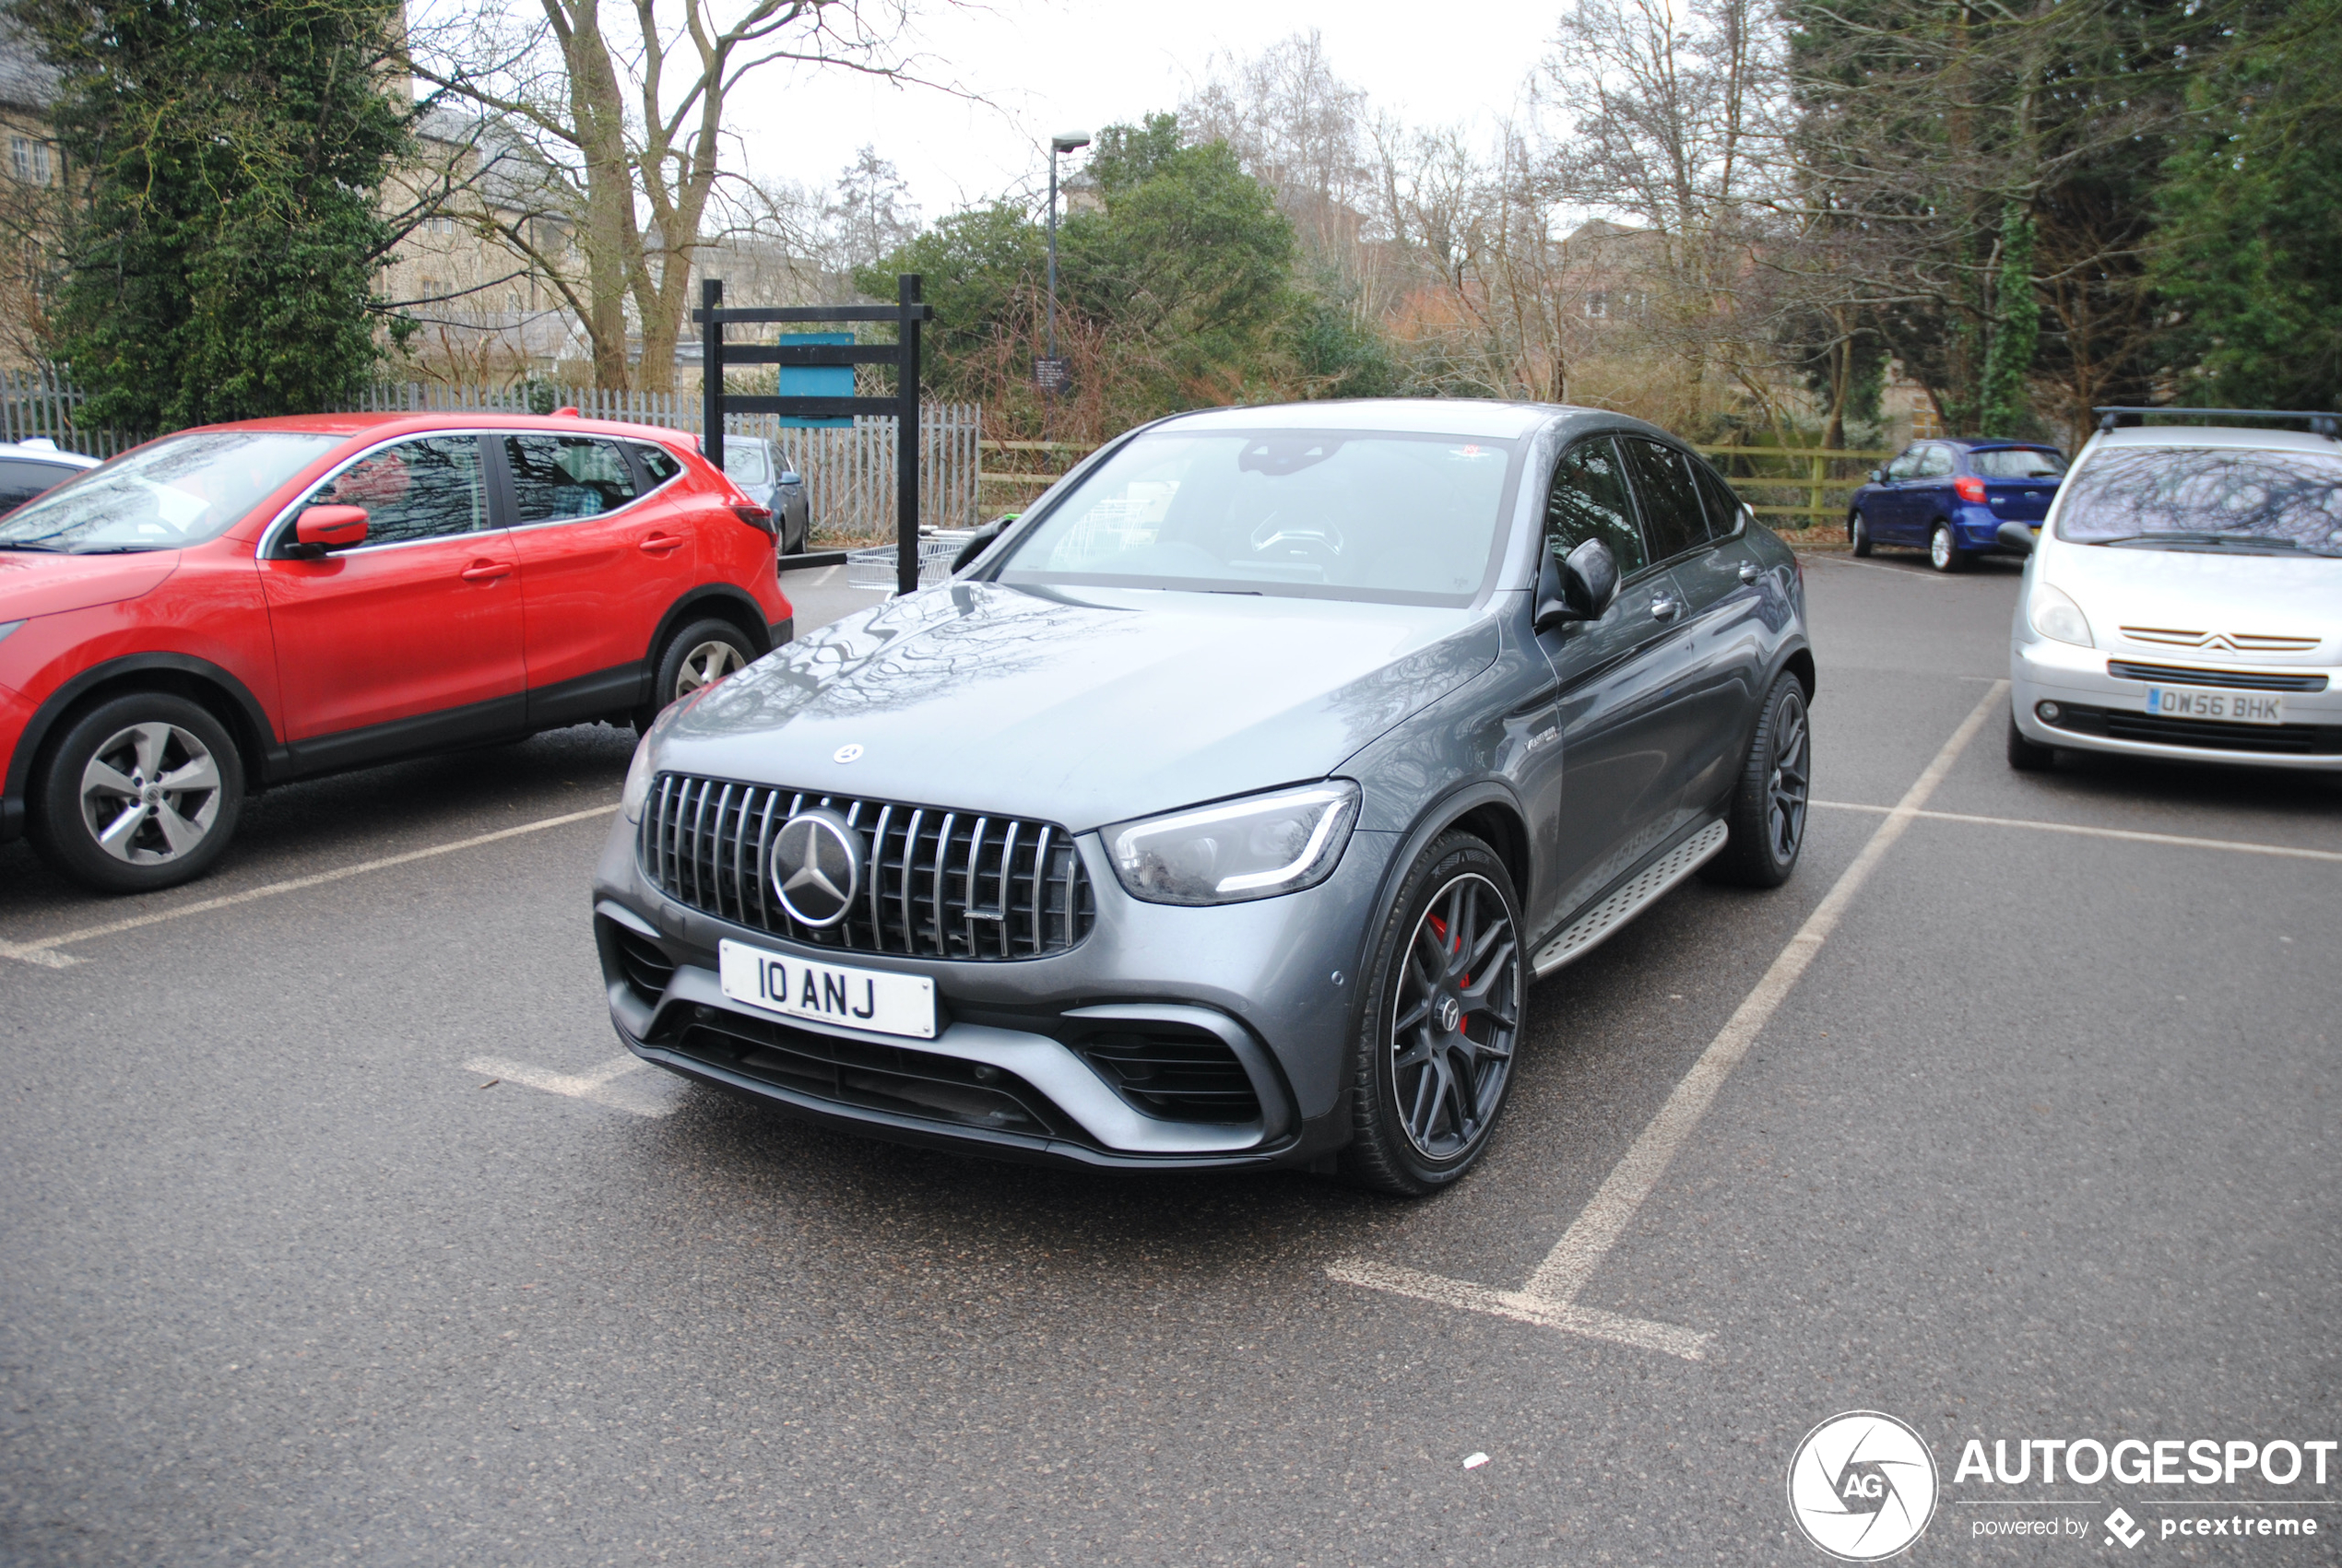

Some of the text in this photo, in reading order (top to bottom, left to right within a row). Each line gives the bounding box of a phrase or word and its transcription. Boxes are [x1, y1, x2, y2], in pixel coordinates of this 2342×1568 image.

[2161, 692, 2277, 719] OW56 BHK
[800, 968, 875, 1020] ANJ
